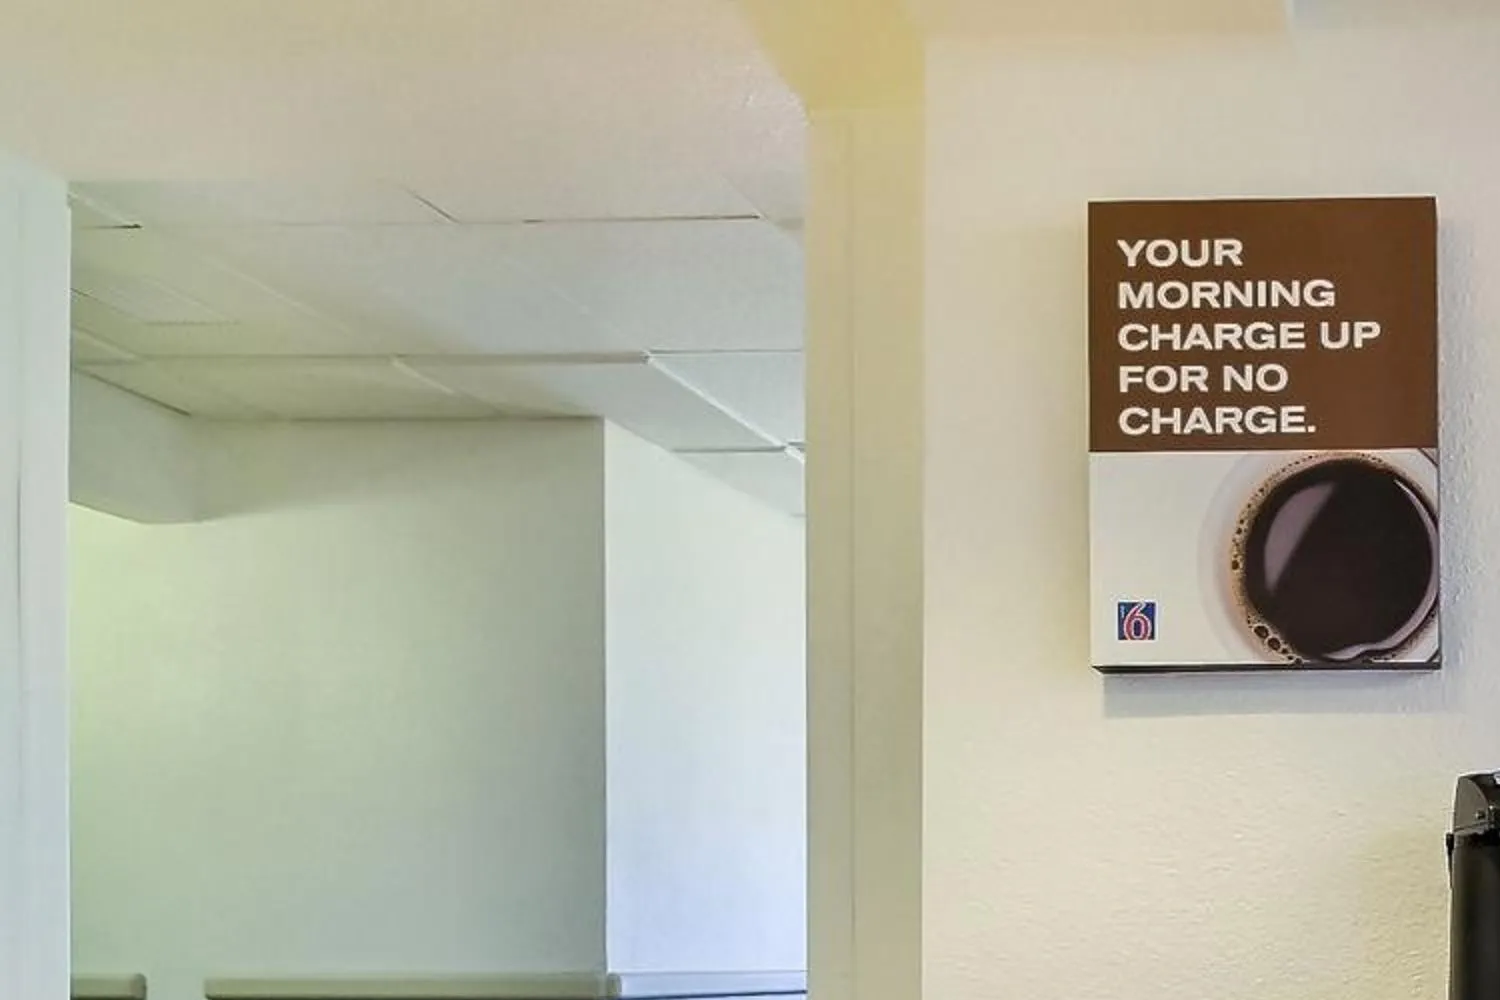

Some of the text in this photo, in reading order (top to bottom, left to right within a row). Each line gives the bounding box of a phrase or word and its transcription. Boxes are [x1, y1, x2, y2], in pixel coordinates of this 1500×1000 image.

[1117, 239, 1243, 267] YOUR
[1118, 279, 1336, 309] MORNING
[1118, 321, 1381, 351] CHARGE UP
[1119, 364, 1288, 393] FOR NO
[1118, 405, 1316, 435] CHARGE.
